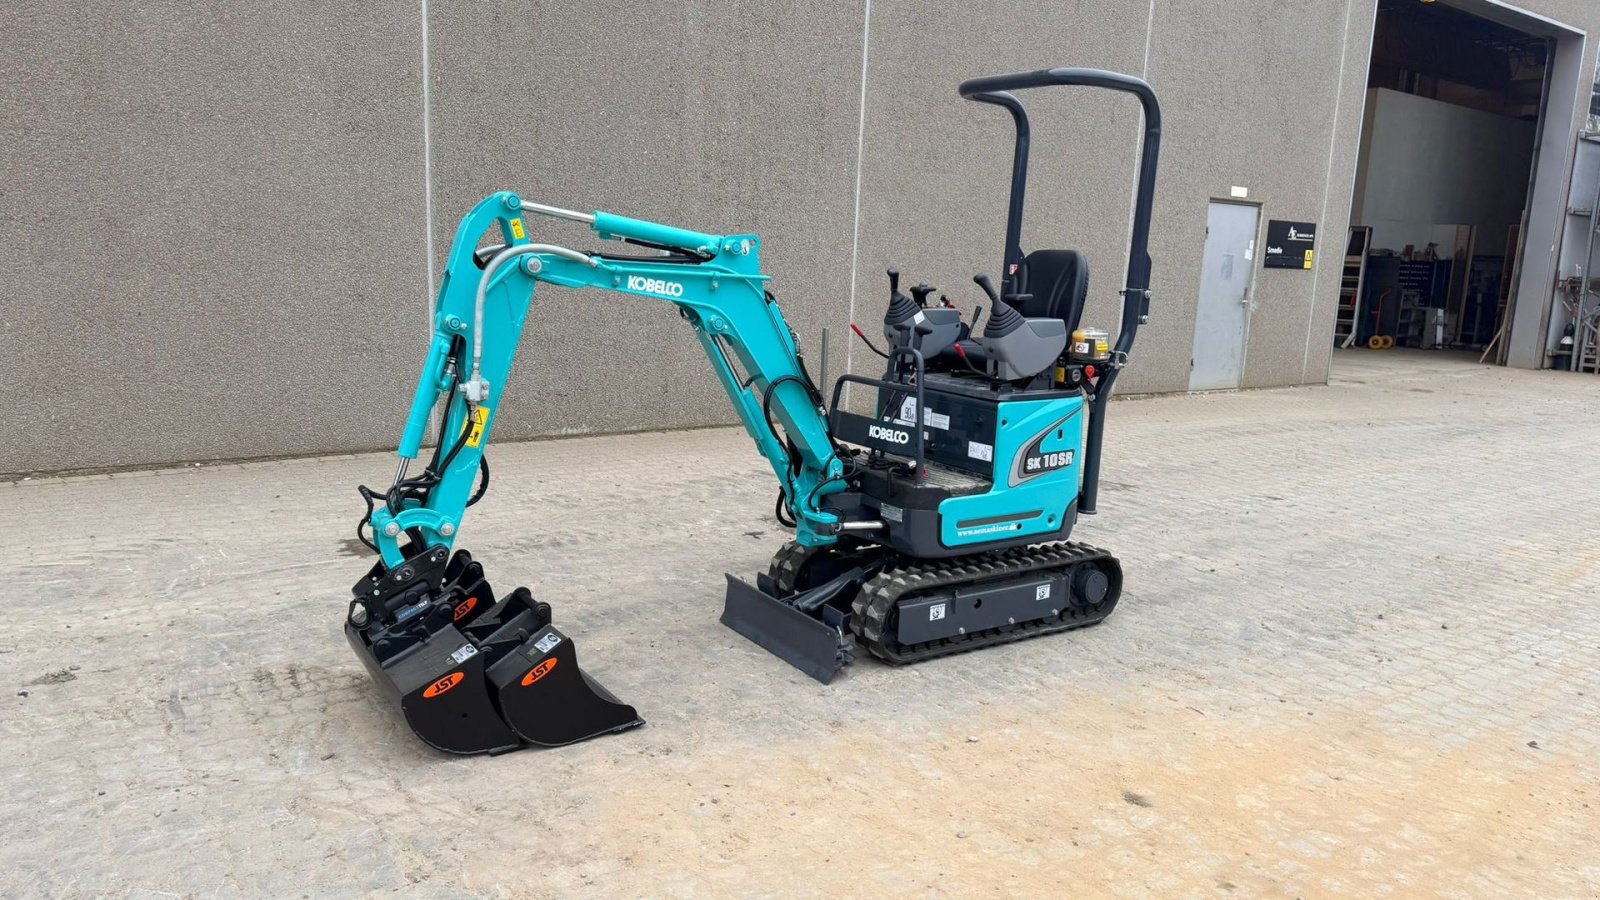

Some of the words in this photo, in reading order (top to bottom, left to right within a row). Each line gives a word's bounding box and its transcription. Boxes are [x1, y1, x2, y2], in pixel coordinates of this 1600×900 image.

[627, 275, 683, 297] KOBELCO
[868, 425, 909, 444] KOBELCO
[1027, 457, 1041, 470] SK
[1043, 452, 1073, 468] 10SR
[456, 603, 470, 618] JST
[531, 662, 548, 680] JST
[434, 676, 453, 693] JST
